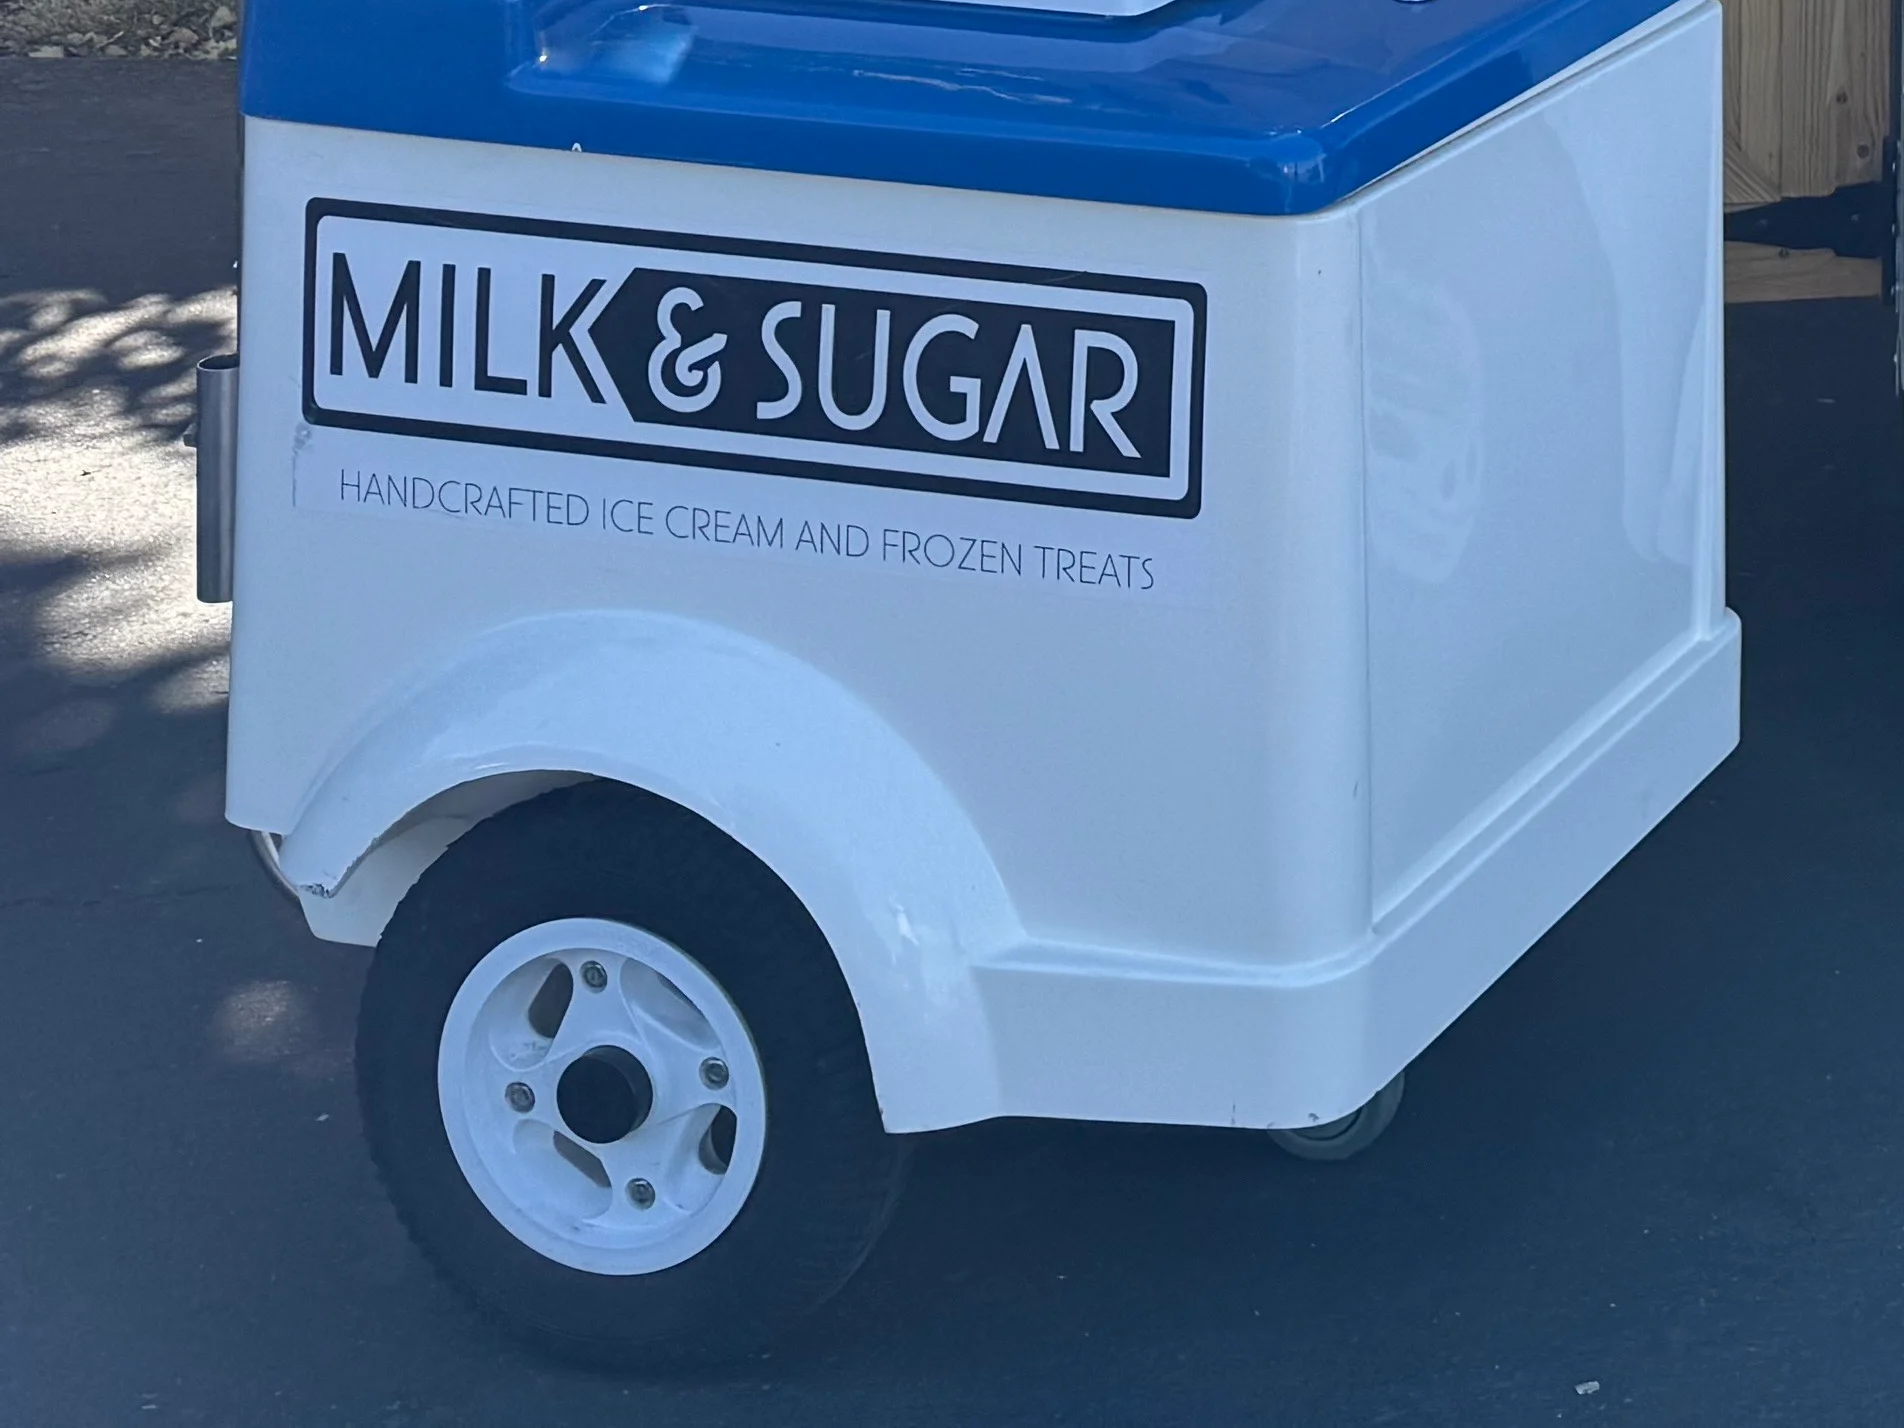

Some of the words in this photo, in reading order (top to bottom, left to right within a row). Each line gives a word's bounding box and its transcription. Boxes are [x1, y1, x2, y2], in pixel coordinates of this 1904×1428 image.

[330, 253, 609, 405] MILK
[646, 286, 727, 413] &
[756, 300, 1142, 459] SUGAR
[339, 467, 590, 528] HANDCRAFTED
[602, 498, 655, 537] ICE
[665, 505, 786, 551] CREAM
[794, 519, 872, 559] AND
[882, 530, 1024, 577] FROZEN
[1033, 545, 1156, 592] TREATS
